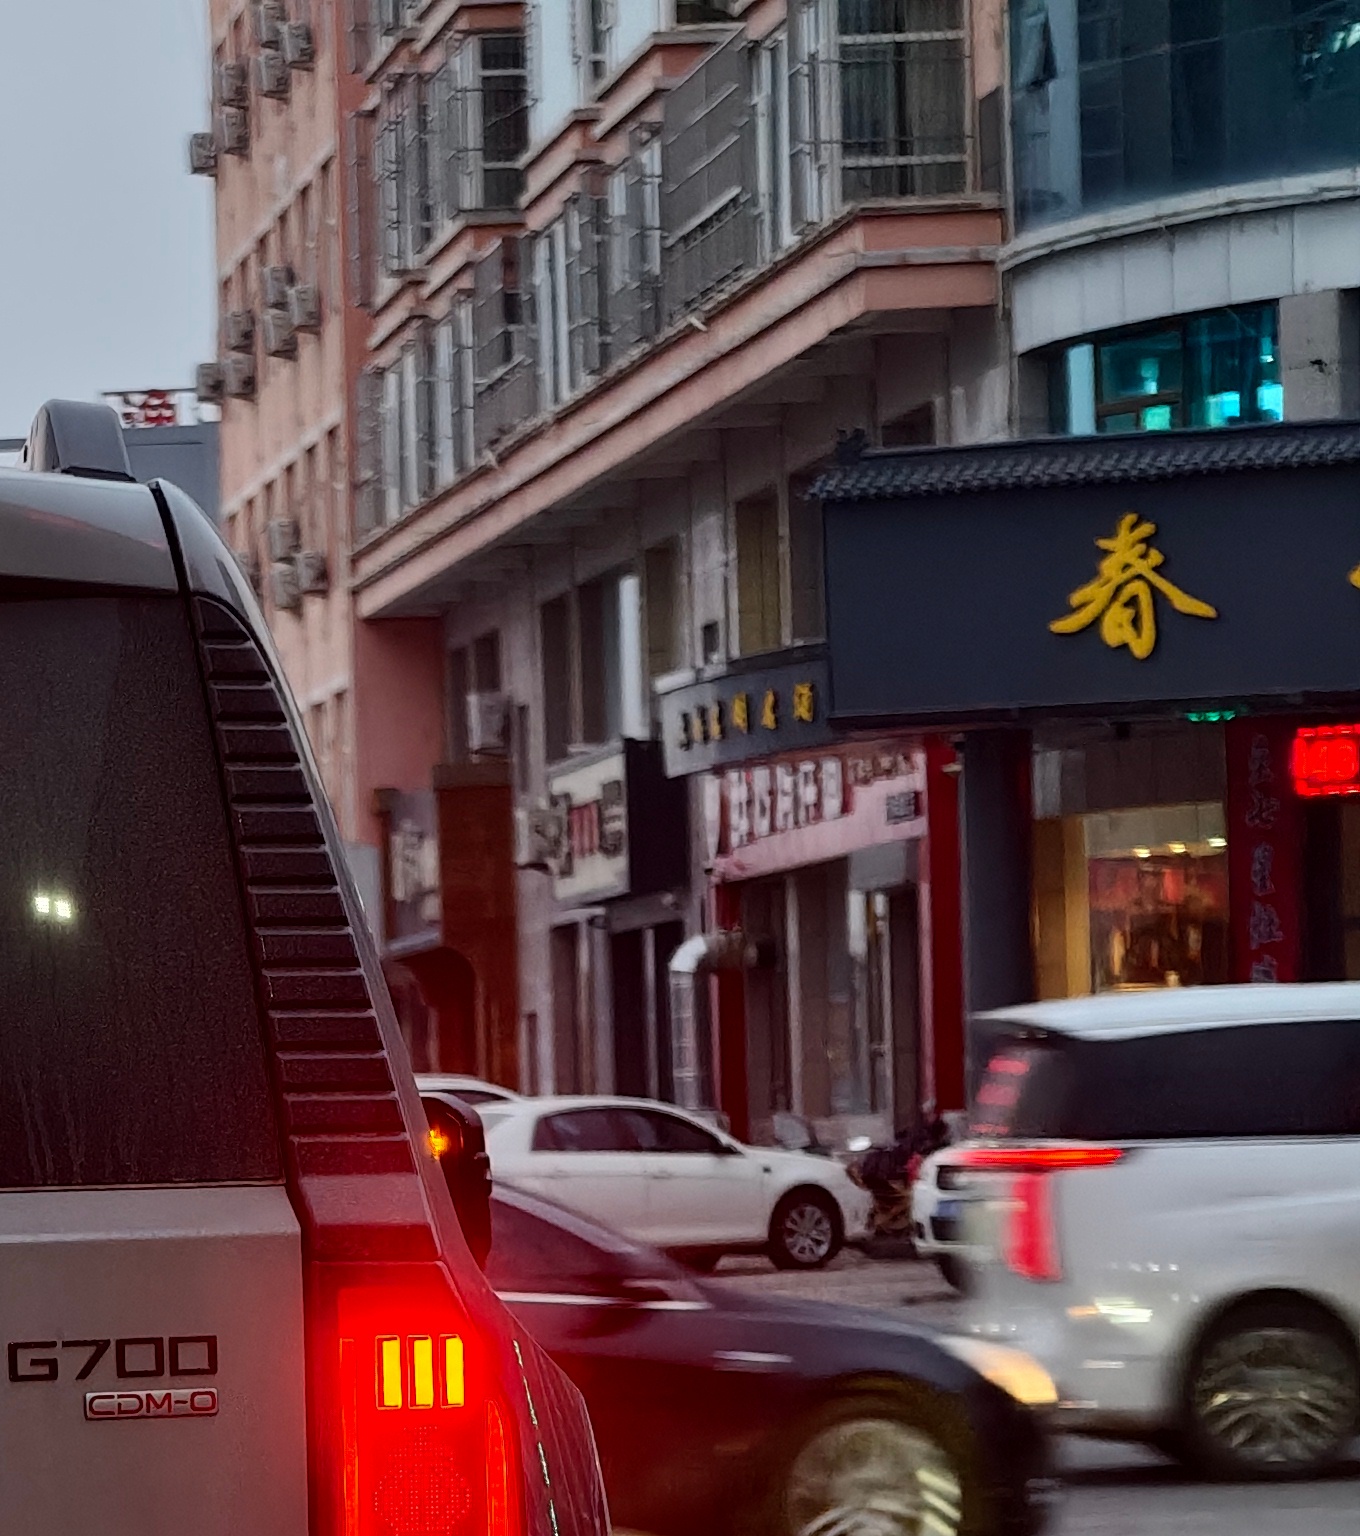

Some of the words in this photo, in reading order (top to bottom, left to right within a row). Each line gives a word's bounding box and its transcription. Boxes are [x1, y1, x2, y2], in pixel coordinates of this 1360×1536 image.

[1048, 511, 1219, 660] 春
[7, 1335, 218, 1382] G700
[87, 1390, 217, 1417] CDM-O
